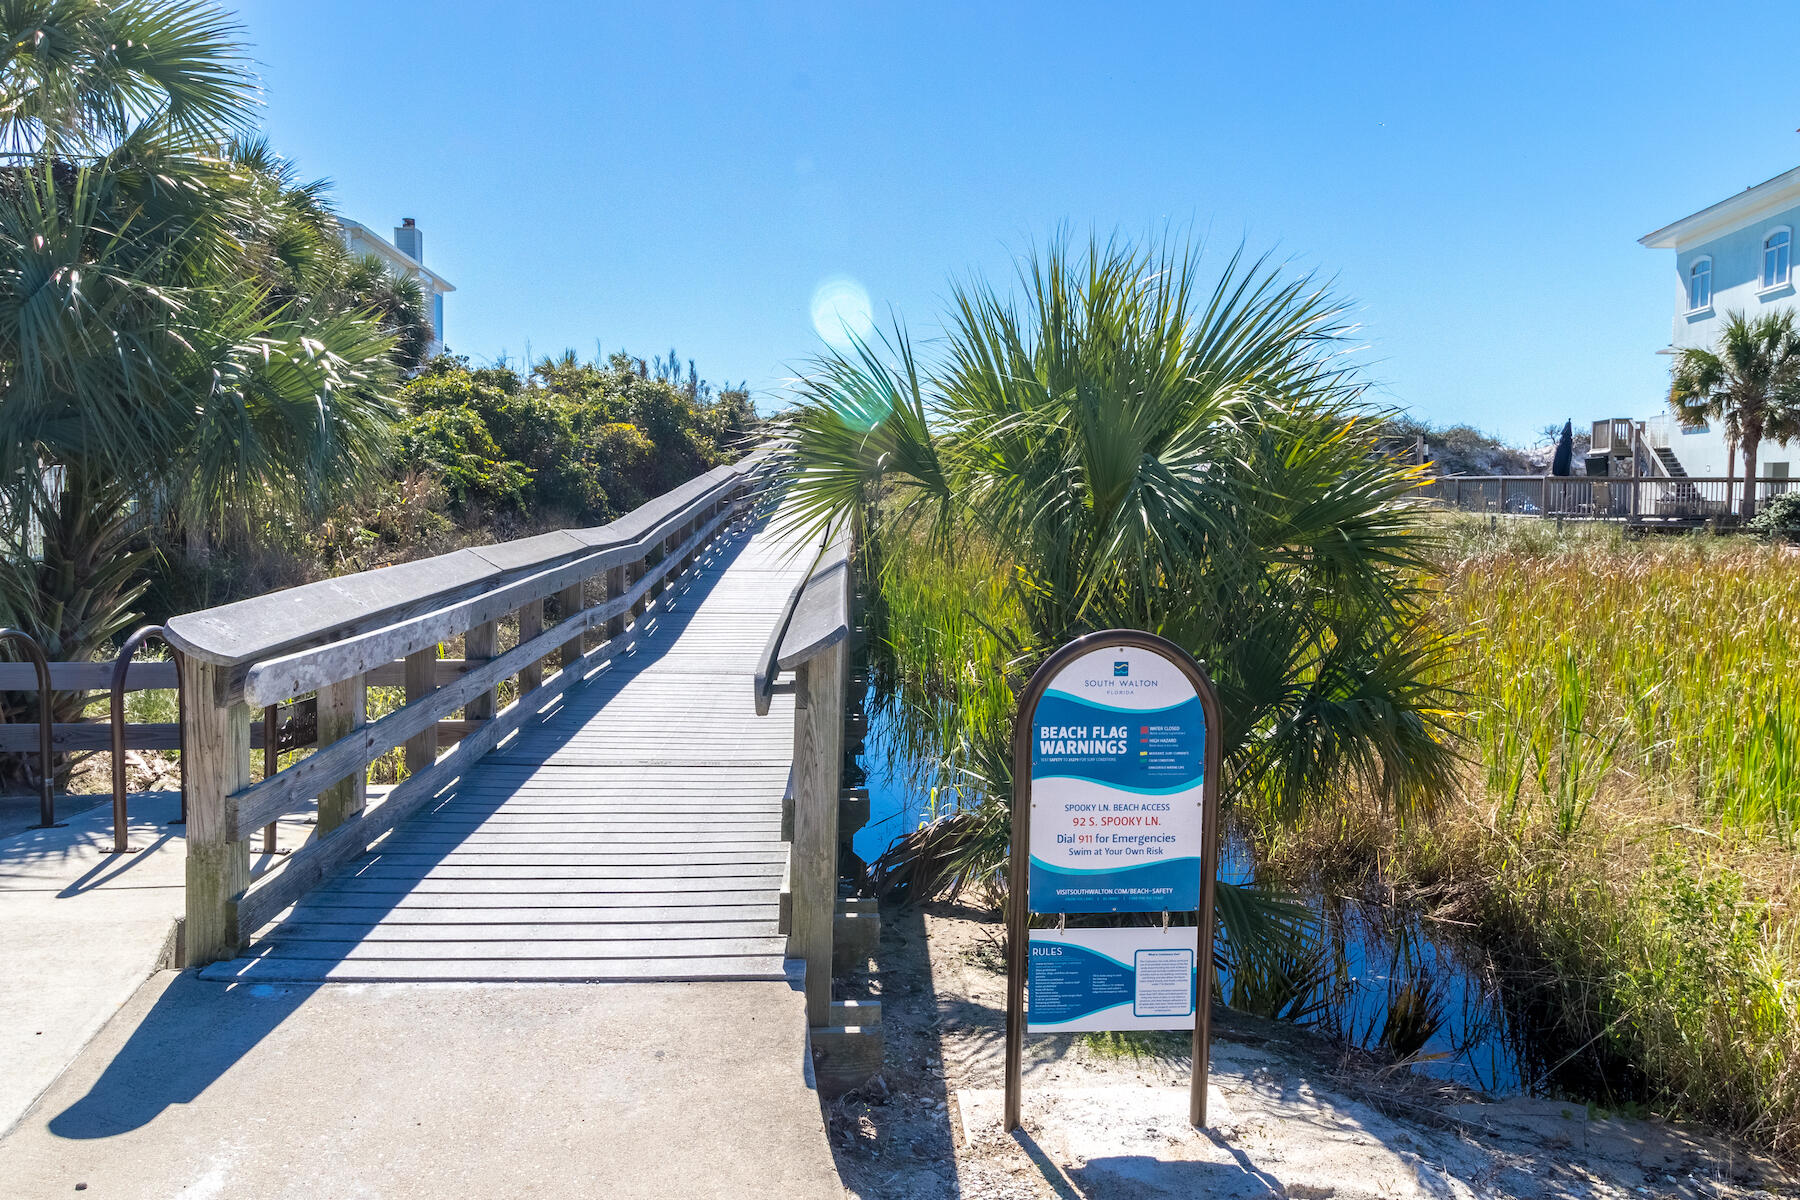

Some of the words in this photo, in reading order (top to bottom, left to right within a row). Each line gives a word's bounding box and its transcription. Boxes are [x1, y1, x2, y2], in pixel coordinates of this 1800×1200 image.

[1041, 726, 1087, 739] BEACH
[1092, 726, 1127, 738] FLAG
[1040, 741, 1127, 754] WARNINGS
[1073, 817, 1086, 826] 92
[1089, 817, 1098, 826] S.
[1101, 817, 1141, 826] SPOOKY
[1145, 817, 1160, 826] LN.
[1057, 834, 1075, 843] Dial
[1079, 835, 1092, 843] 911
[1095, 834, 1109, 843] for
[1113, 833, 1175, 845] Emergencies
[1033, 948, 1062, 956] RULES
